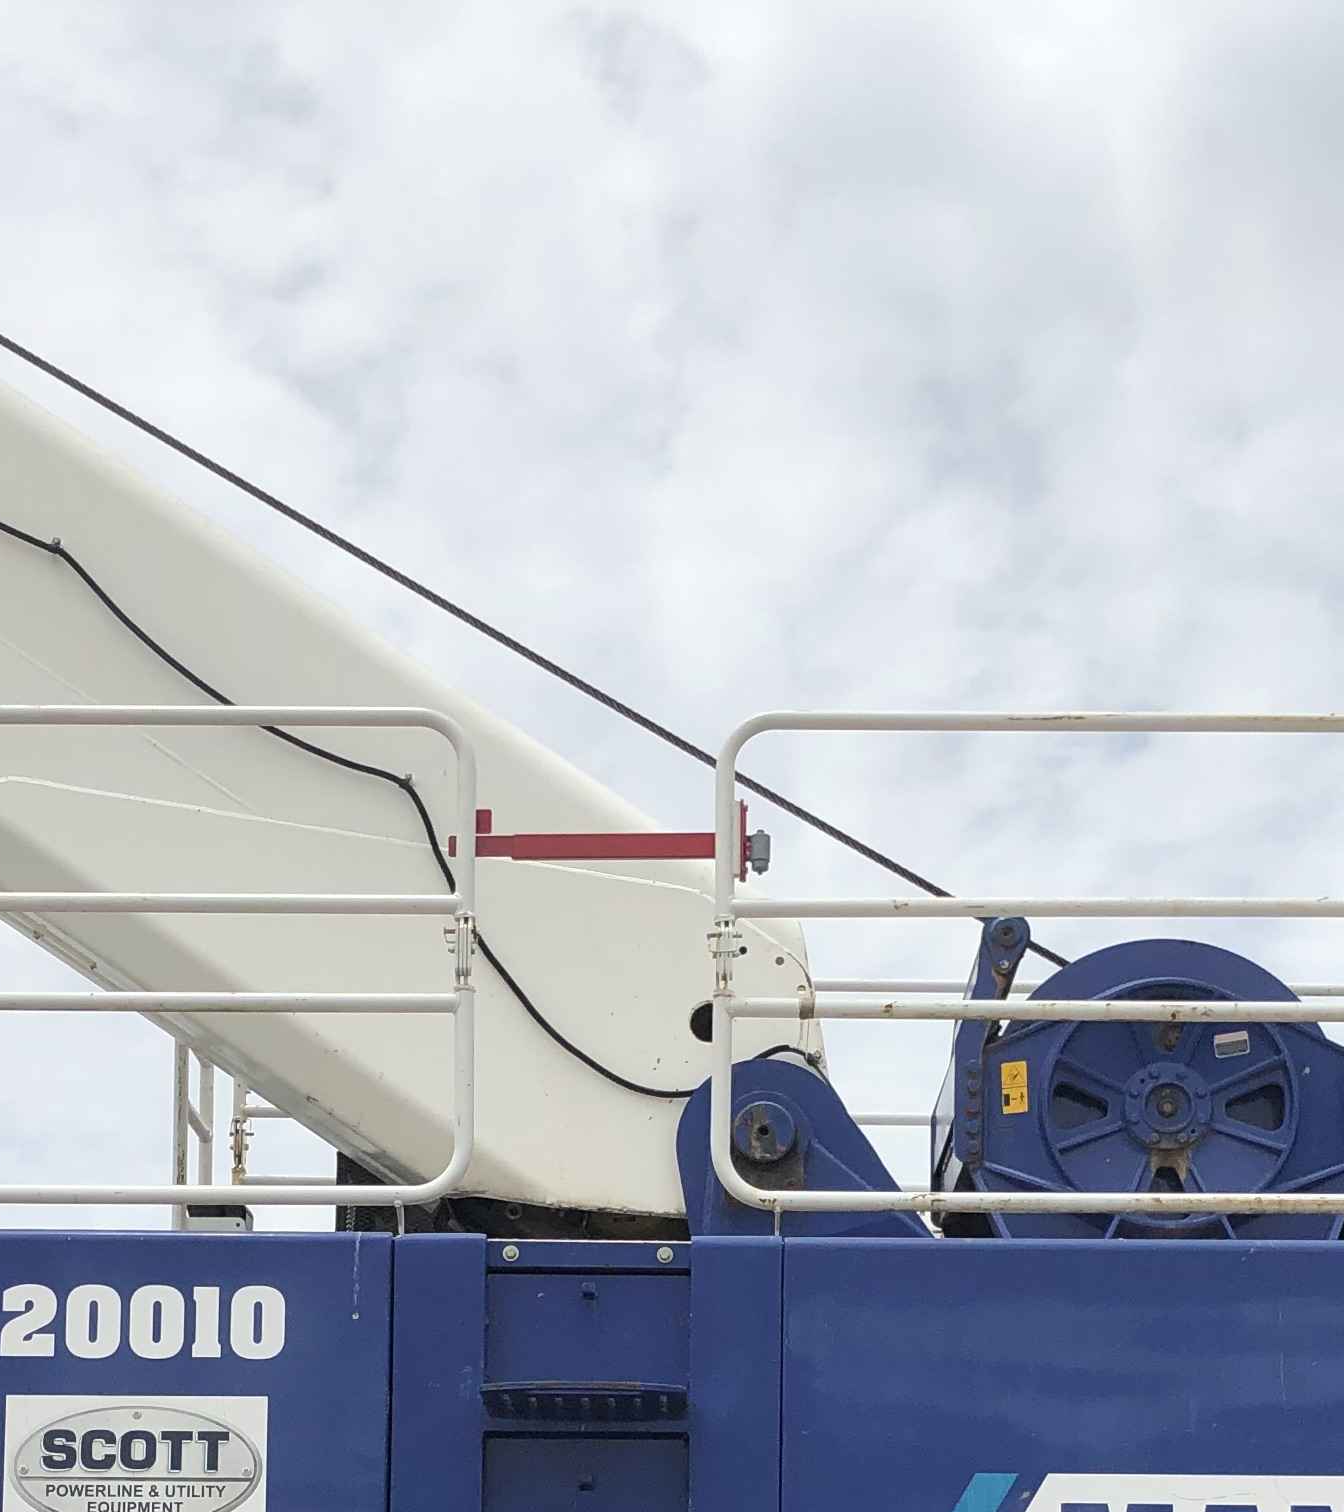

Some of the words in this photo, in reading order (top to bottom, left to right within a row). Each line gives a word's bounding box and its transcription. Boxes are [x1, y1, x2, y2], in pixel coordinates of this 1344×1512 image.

[0, 1283, 286, 1360] 20010
[41, 1429, 230, 1473] SCOTT
[45, 1484, 143, 1498] POWERLINE
[148, 1484, 160, 1498] &
[165, 1484, 227, 1498] UTILITY
